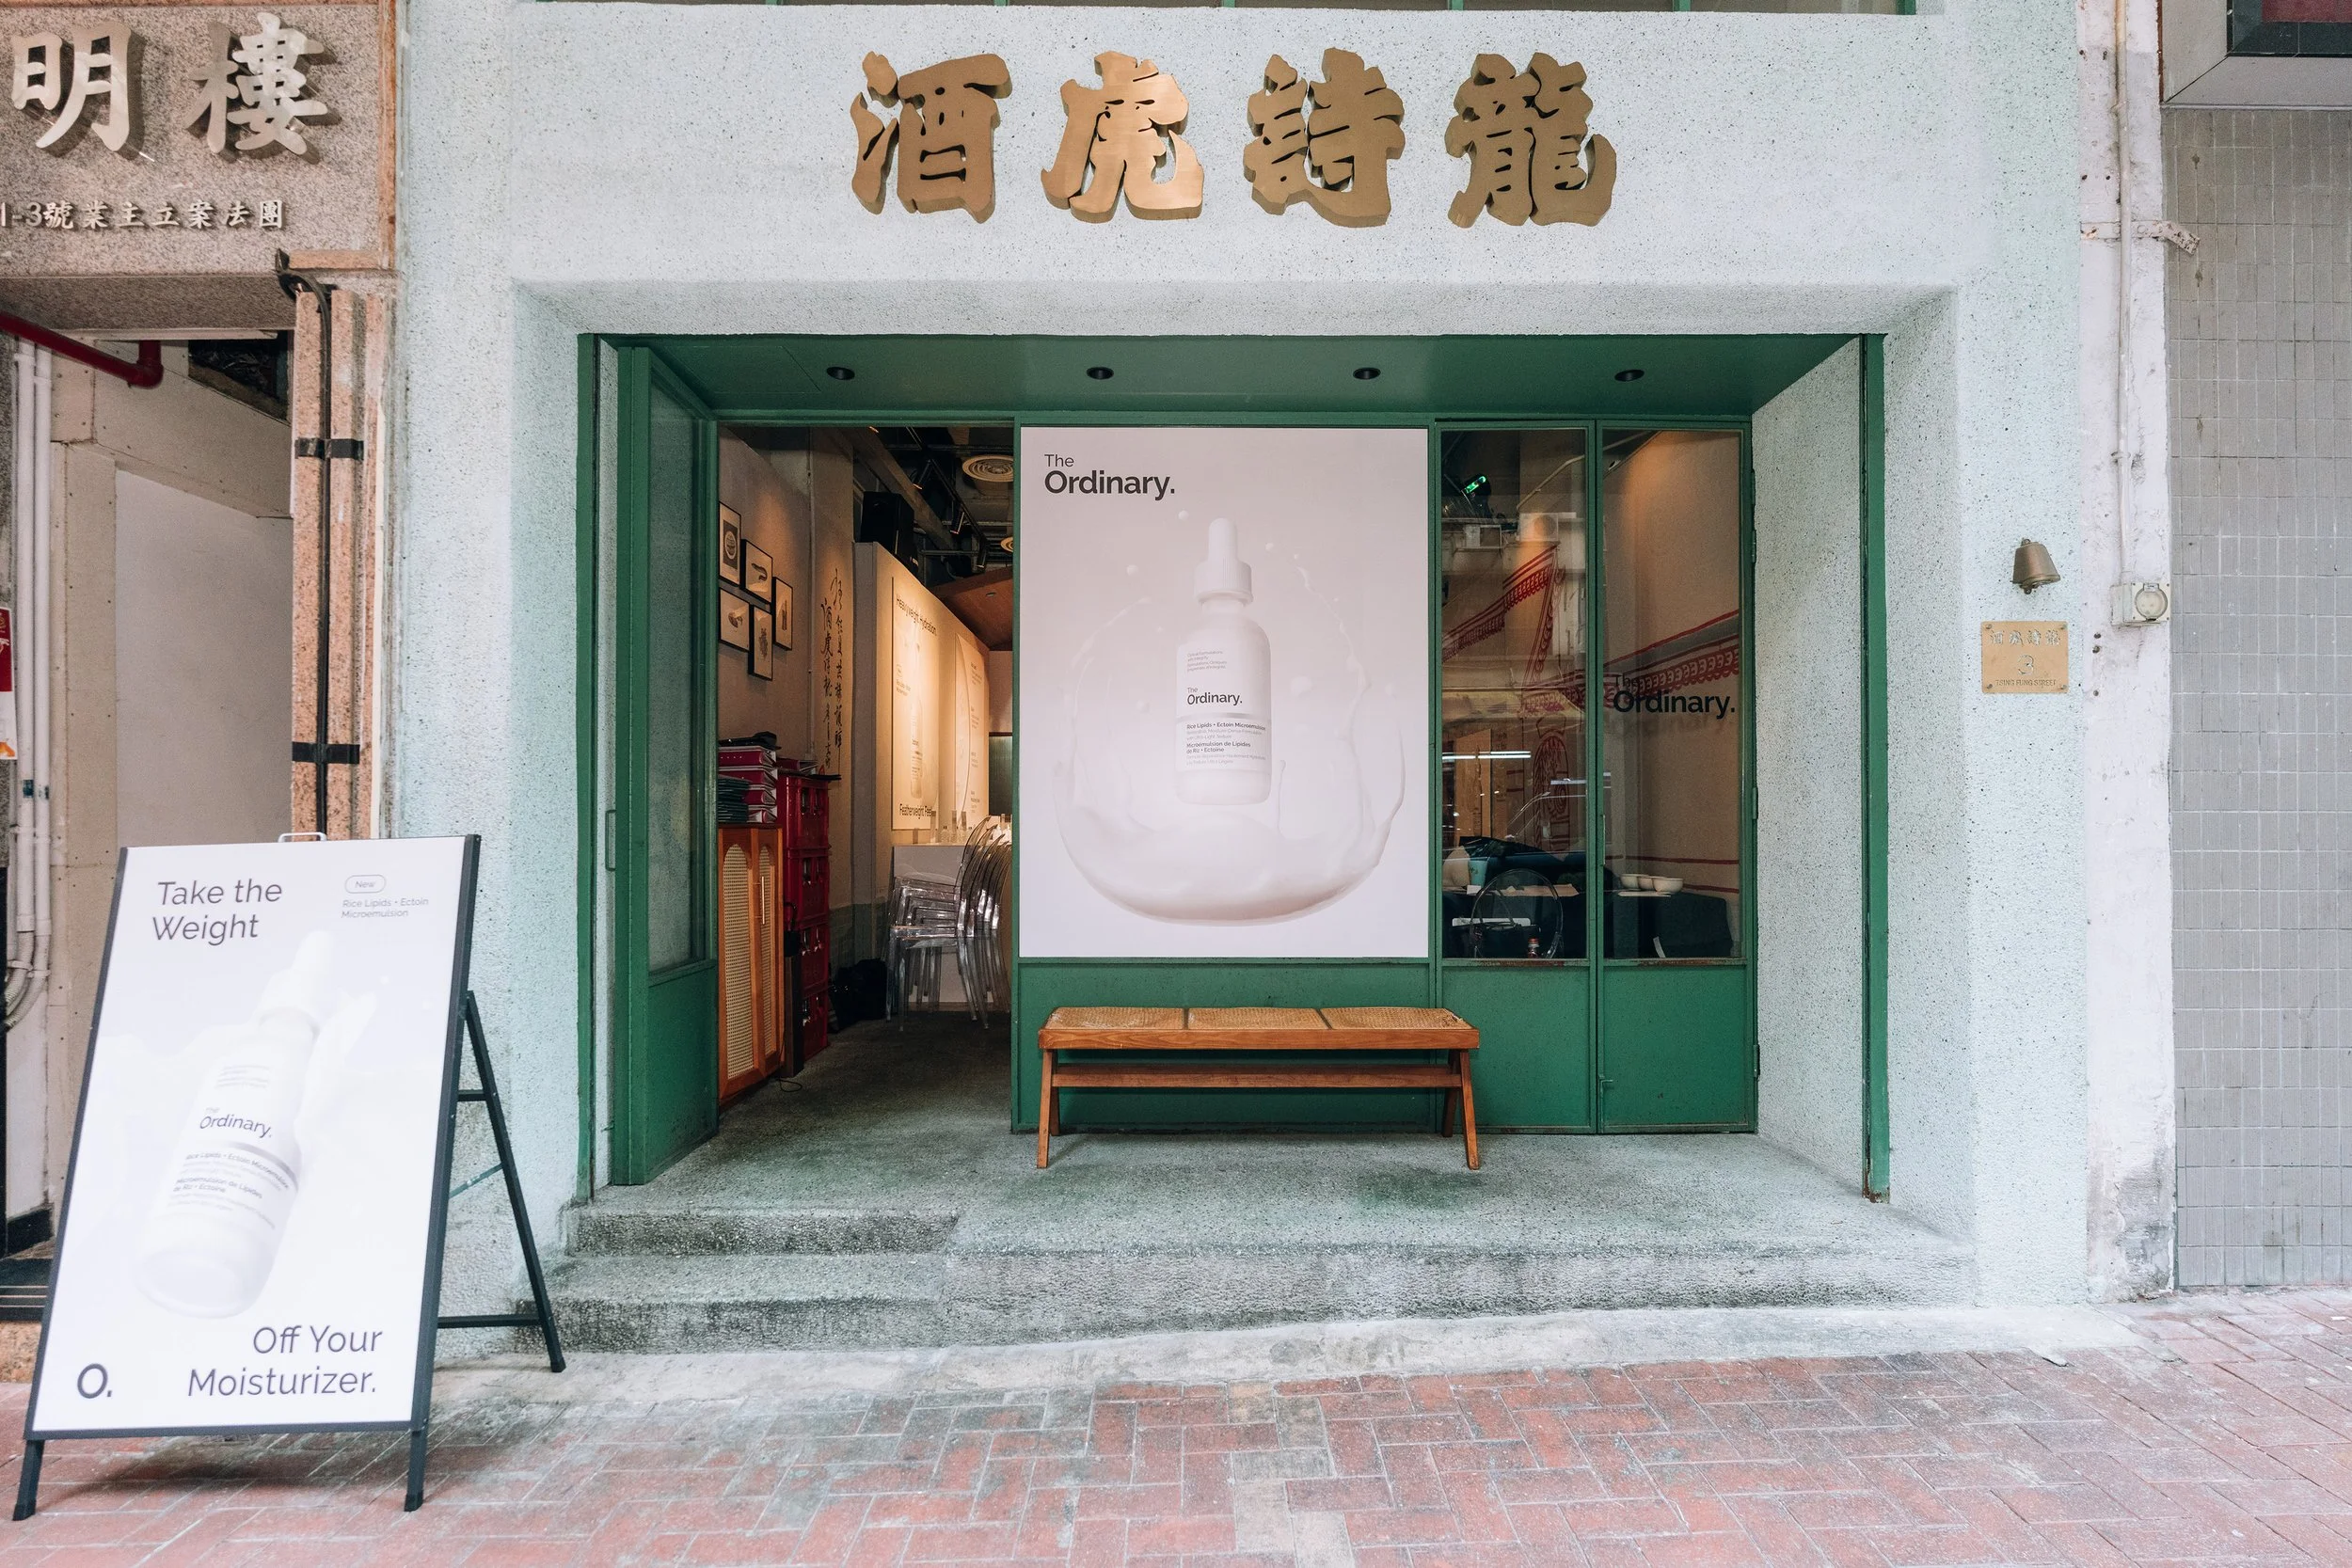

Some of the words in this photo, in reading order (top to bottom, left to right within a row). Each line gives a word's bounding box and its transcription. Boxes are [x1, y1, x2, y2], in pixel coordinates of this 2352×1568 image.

[850, 47, 1617, 228] 酒虎詩龍
[1044, 453, 1074, 467] The
[1044, 469, 1176, 501] Ordinary.
[2017, 654, 2035, 675] 3
[1187, 692, 1243, 706] Ordinary.
[1613, 689, 1736, 720] Ordinary.
[157, 879, 224, 906] Take
[234, 878, 282, 904] the
[354, 880, 376, 889] New
[340, 909, 409, 919] Microemulsion
[342, 899, 363, 908] Rice
[364, 897, 392, 909] Lipids
[400, 896, 430, 907] Ectoin
[152, 913, 260, 946] Weight
[199, 1114, 272, 1139] Ordinary.
[253, 1324, 302, 1354] Off
[310, 1324, 382, 1353] Your
[77, 1363, 113, 1399] O.
[187, 1366, 377, 1398] Moisturizer.
